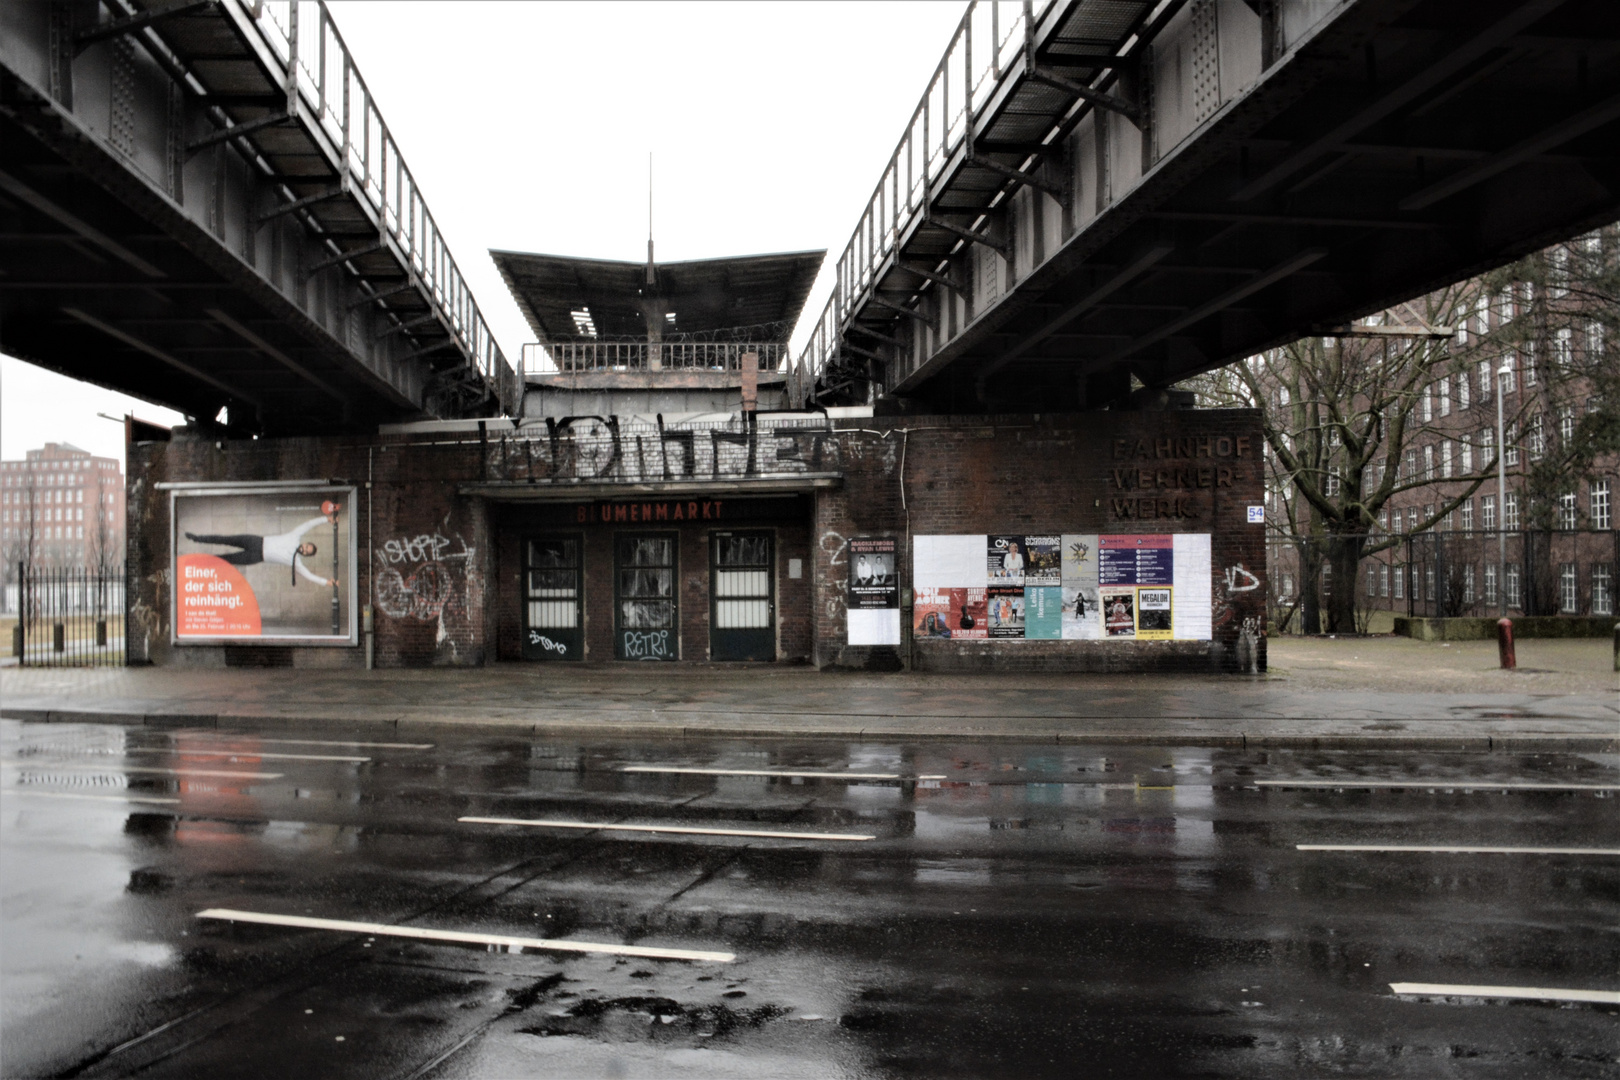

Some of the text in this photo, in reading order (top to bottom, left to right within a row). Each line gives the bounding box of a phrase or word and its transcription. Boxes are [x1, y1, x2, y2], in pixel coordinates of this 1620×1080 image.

[577, 501, 723, 523] BLUMENMARKT
[1248, 507, 1263, 517] 54
[185, 566, 218, 579] Einer,
[185, 579, 232, 592] der sich
[185, 594, 244, 609] reinhängt.
[1142, 593, 1168, 603] MEGALOH
